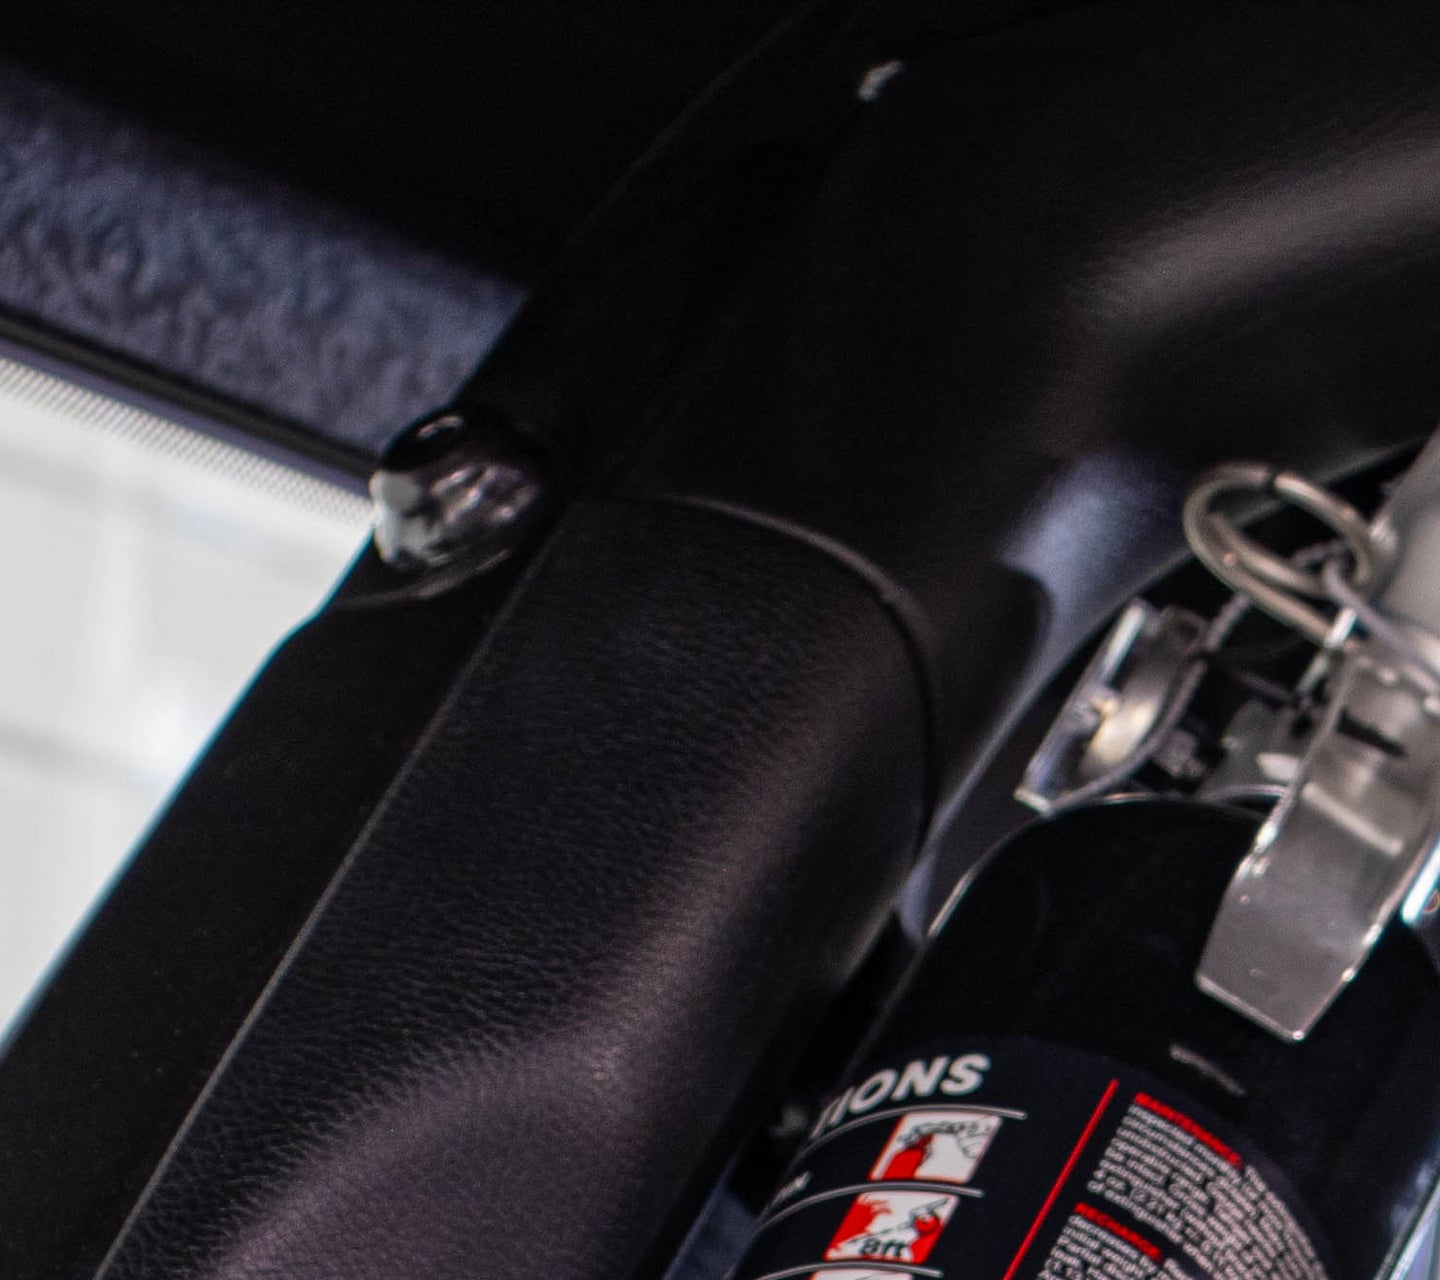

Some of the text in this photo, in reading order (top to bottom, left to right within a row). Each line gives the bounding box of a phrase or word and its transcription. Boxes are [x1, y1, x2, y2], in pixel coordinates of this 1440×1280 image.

[1129, 1106, 1194, 1146] inspected
[1194, 1144, 1242, 1186] monthly
[1057, 1236, 1102, 1265] Partial
[1069, 1216, 1138, 1260] decreases
[1075, 1203, 1159, 1258] RECHARGE:
